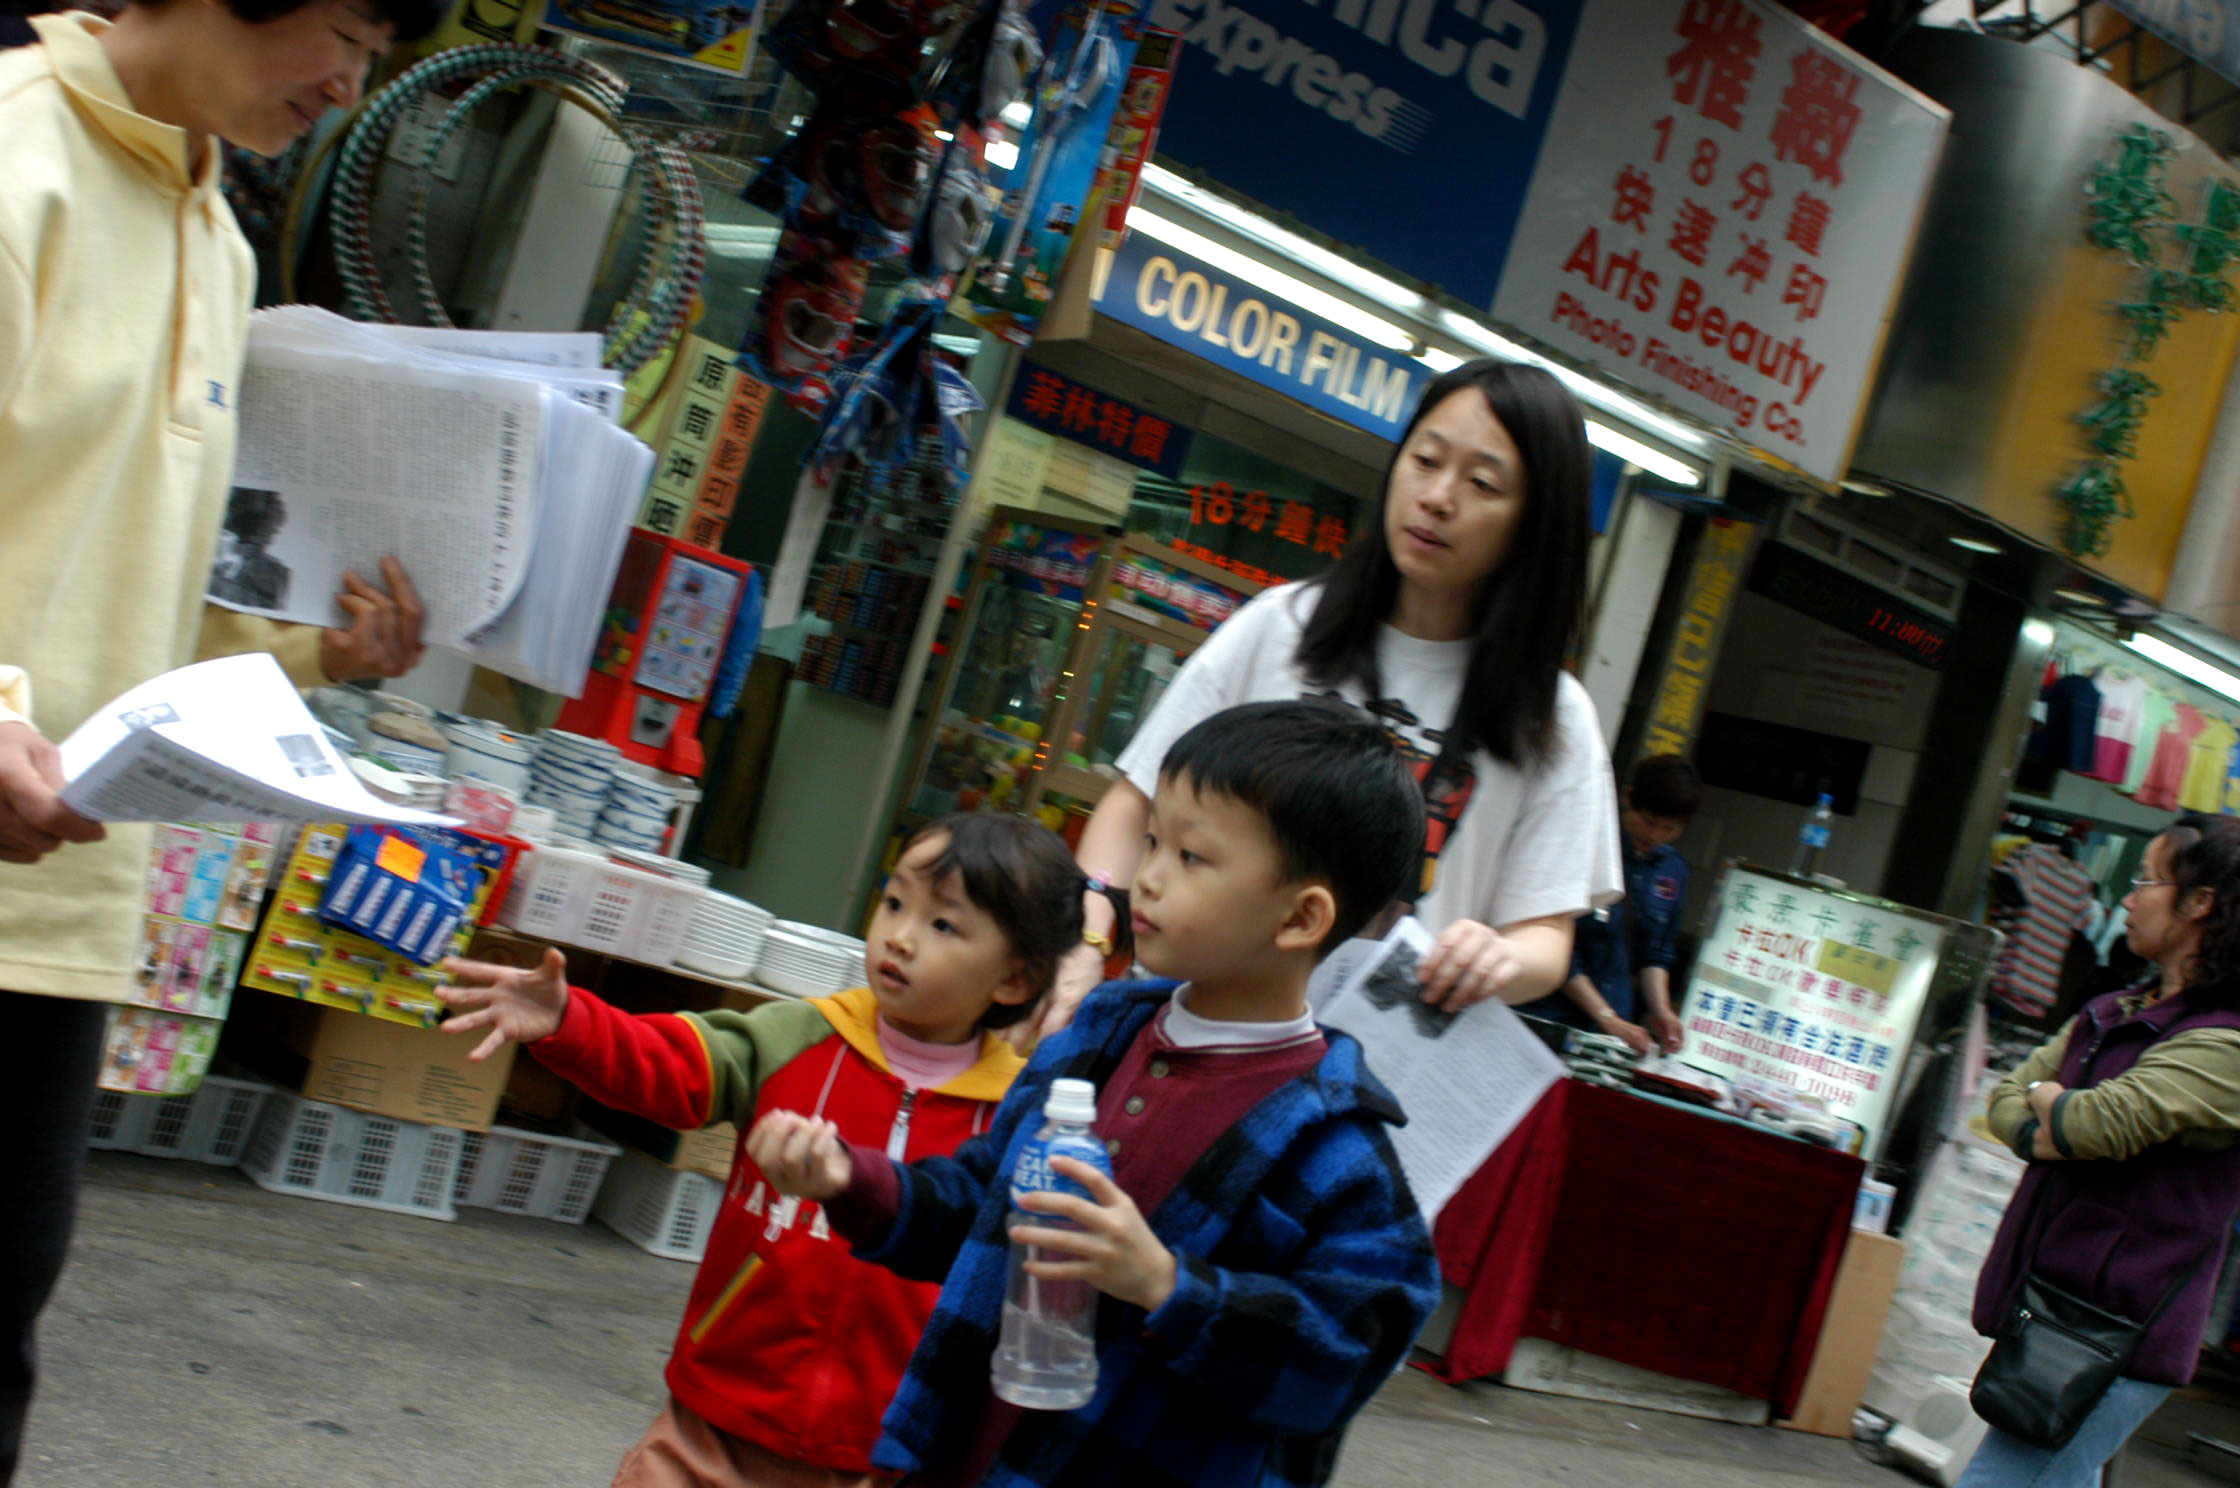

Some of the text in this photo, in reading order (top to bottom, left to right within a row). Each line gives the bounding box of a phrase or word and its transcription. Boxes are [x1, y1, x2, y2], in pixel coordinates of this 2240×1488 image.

[1136, 256, 1301, 375] COLOR
[1300, 330, 1411, 424] FILM
[1551, 291, 1636, 357] Photo
[1640, 337, 1759, 428] Finishing
[1561, 225, 1826, 406] Arts Beauty
